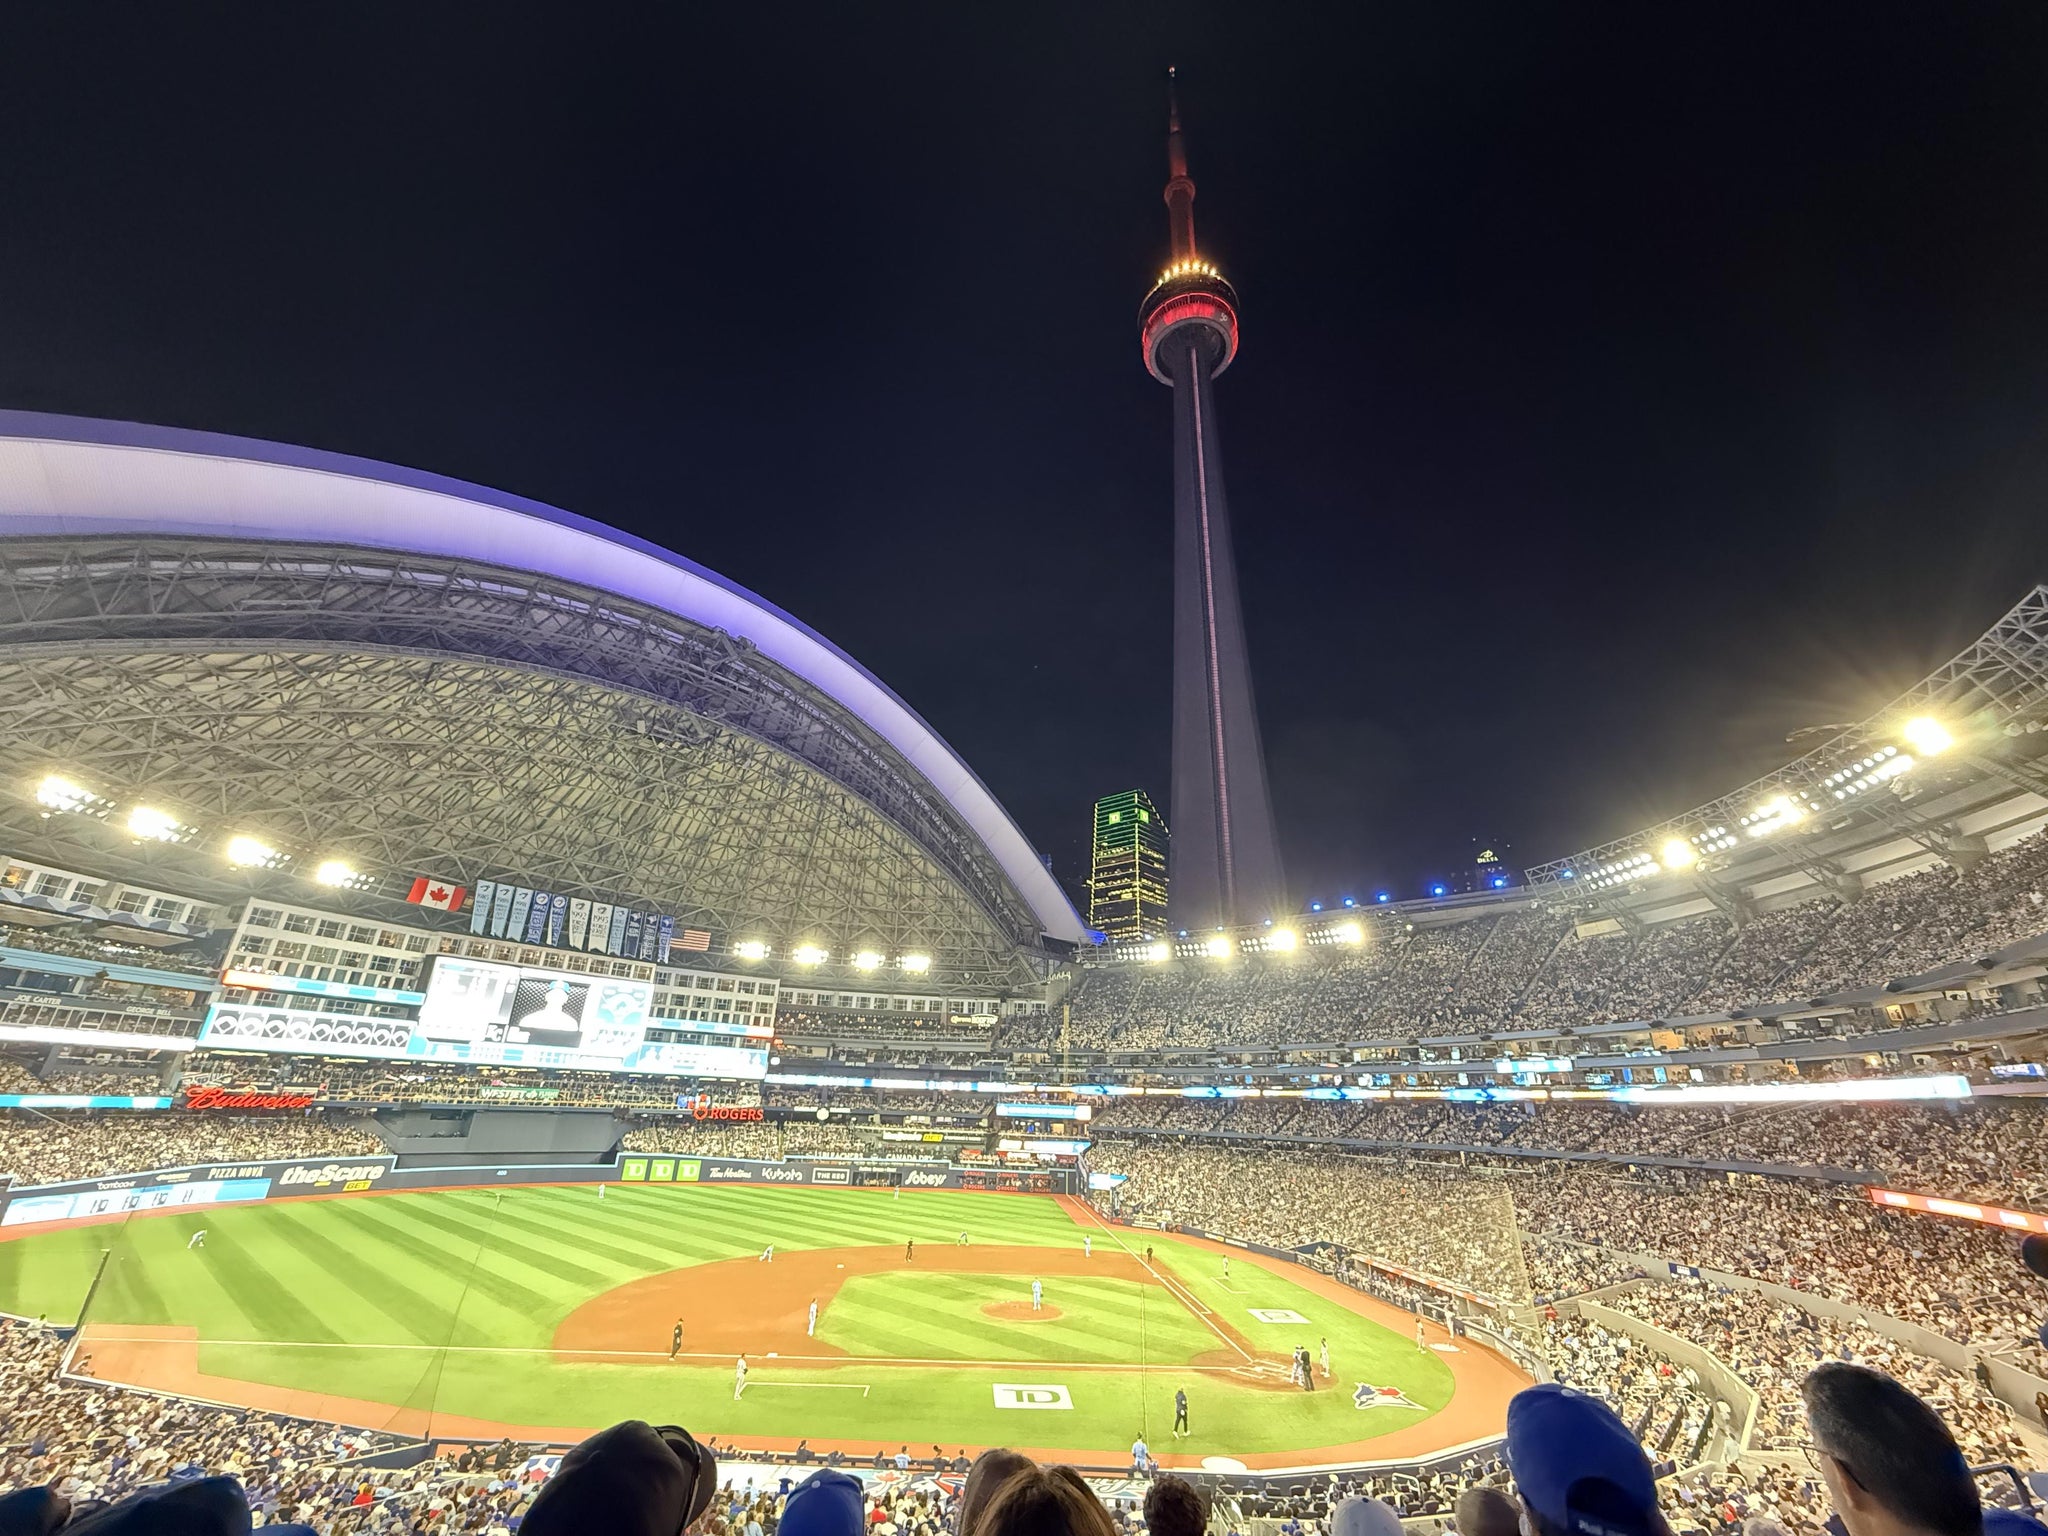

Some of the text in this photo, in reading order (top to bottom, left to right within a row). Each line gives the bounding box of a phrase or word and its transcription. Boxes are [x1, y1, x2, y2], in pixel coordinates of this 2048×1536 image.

[14, 994, 62, 1005] JOE CARTER
[126, 1006, 172, 1016] GEORGE BELL
[186, 1086, 312, 1109] Budweiser
[481, 1088, 527, 1099] WESTJET
[711, 1109, 764, 1121] ROGERS
[208, 1166, 265, 1179] PIZZA NOVA
[279, 1164, 385, 1185] theScore
[628, 1163, 644, 1177] TD
[655, 1164, 671, 1177] TD
[682, 1164, 699, 1177] TD
[709, 1167, 752, 1179] Tim Hortons
[762, 1167, 803, 1181] Kubota
[905, 1170, 947, 1187] Sobeys
[346, 1181, 370, 1190] BET
[1001, 1388, 1061, 1403] TD
